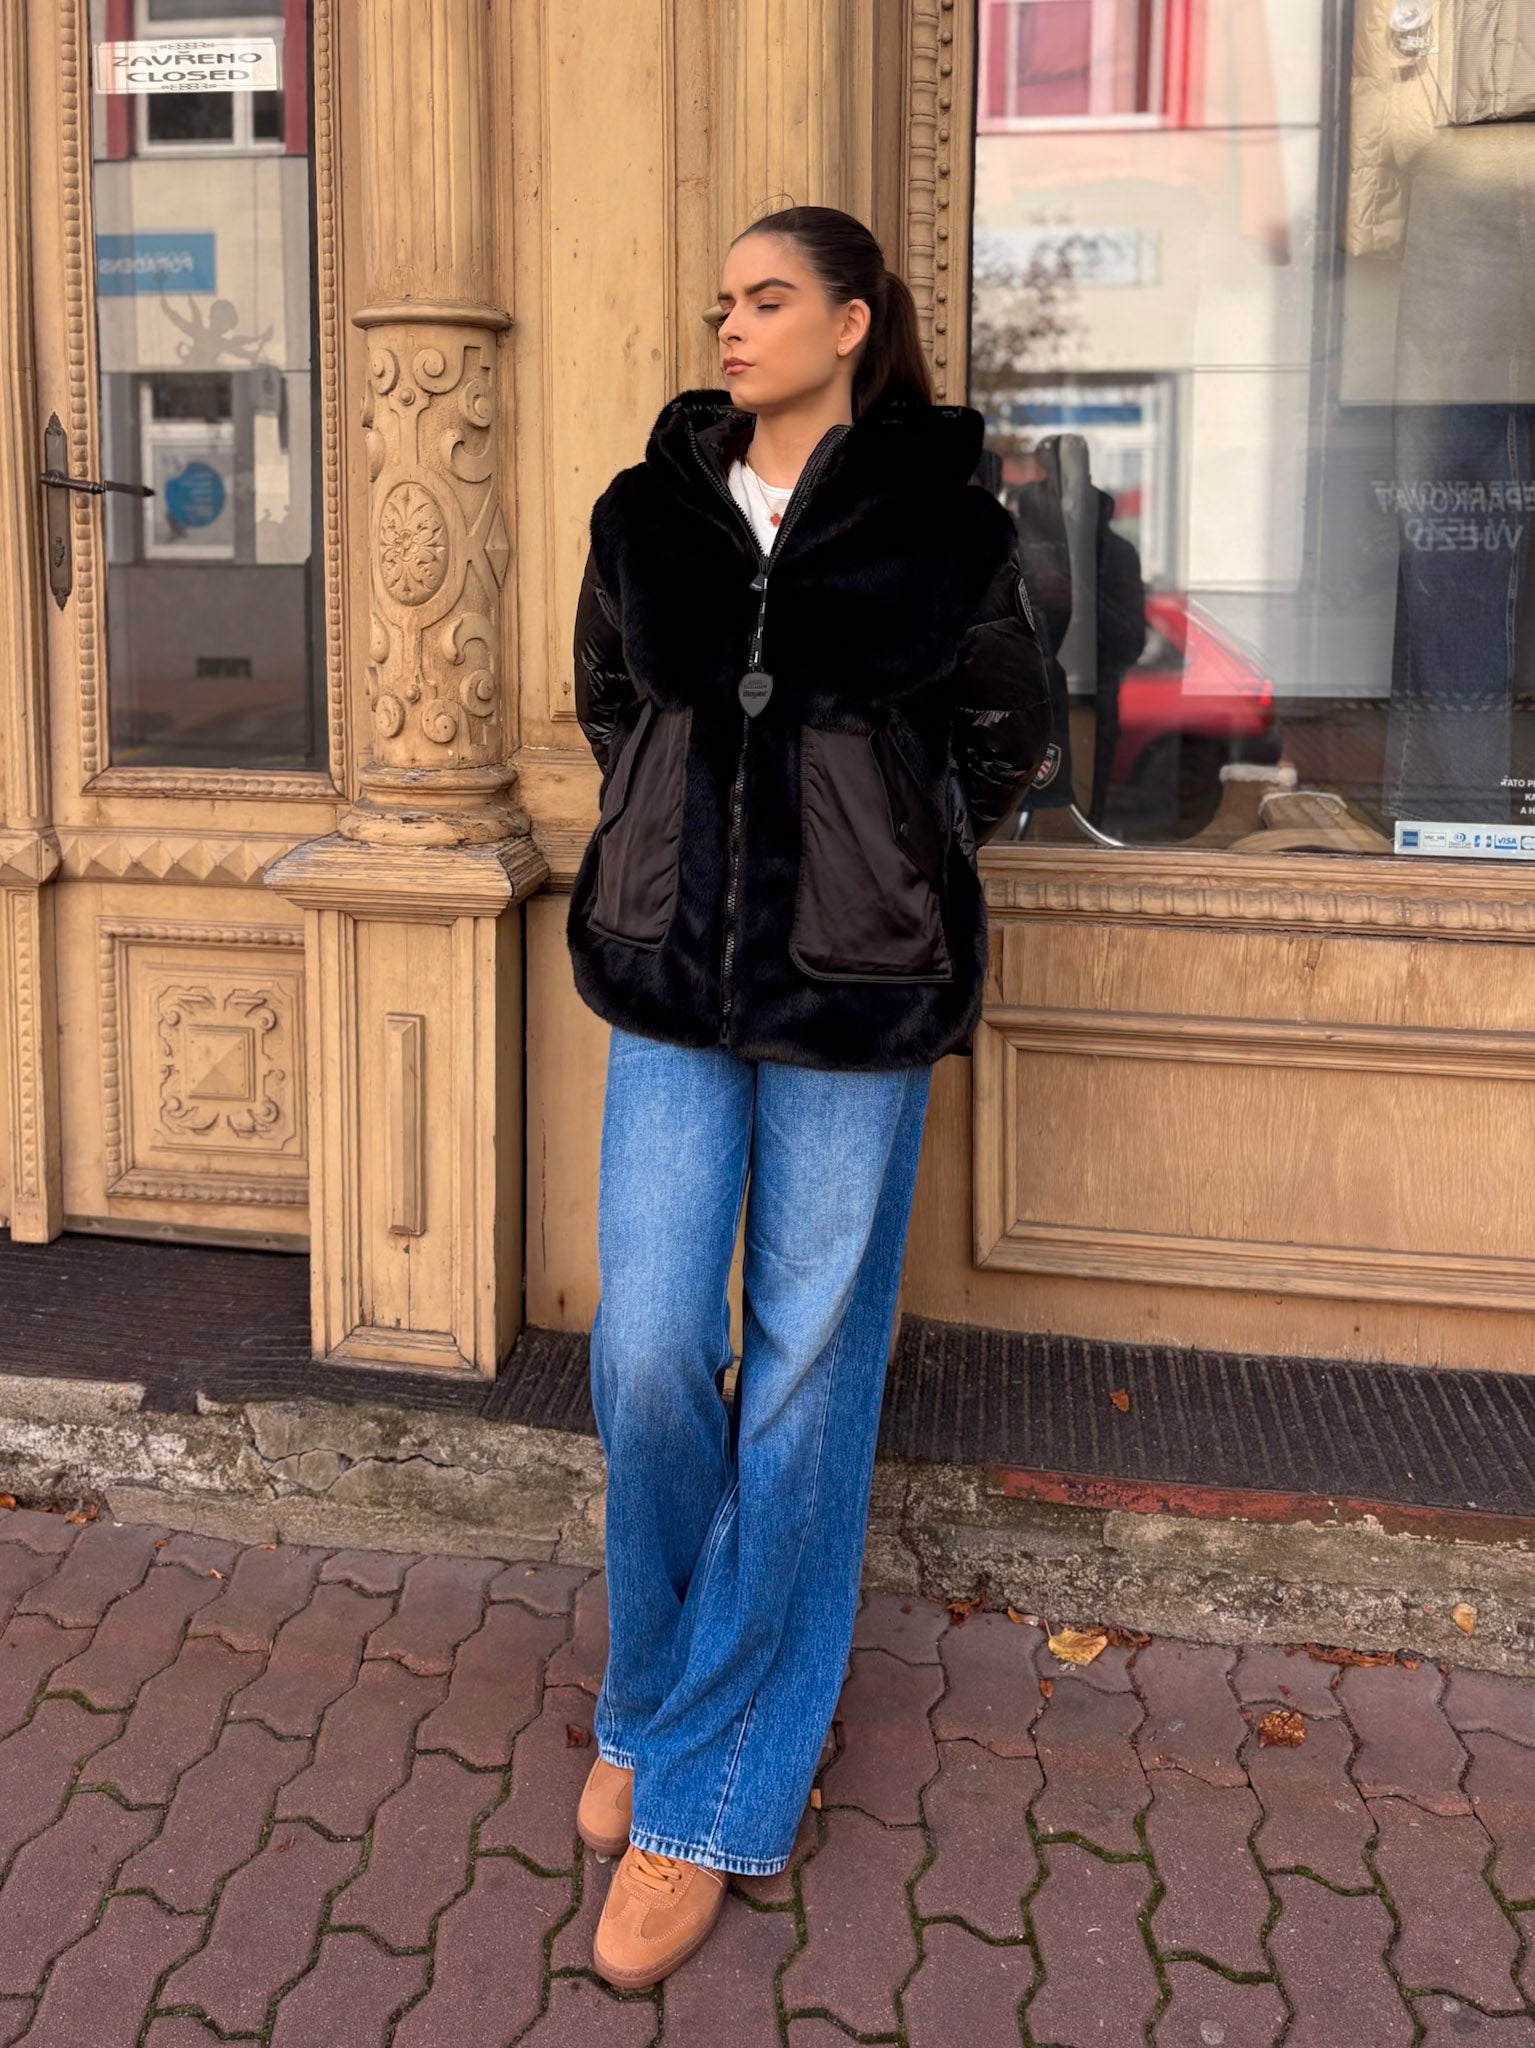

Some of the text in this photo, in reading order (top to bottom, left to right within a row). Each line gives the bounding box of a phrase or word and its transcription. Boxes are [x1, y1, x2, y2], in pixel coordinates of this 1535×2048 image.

[112, 51, 262, 67] ZAVŘENO
[126, 70, 250, 82] CLOSED
[1498, 836, 1517, 845] VISA
